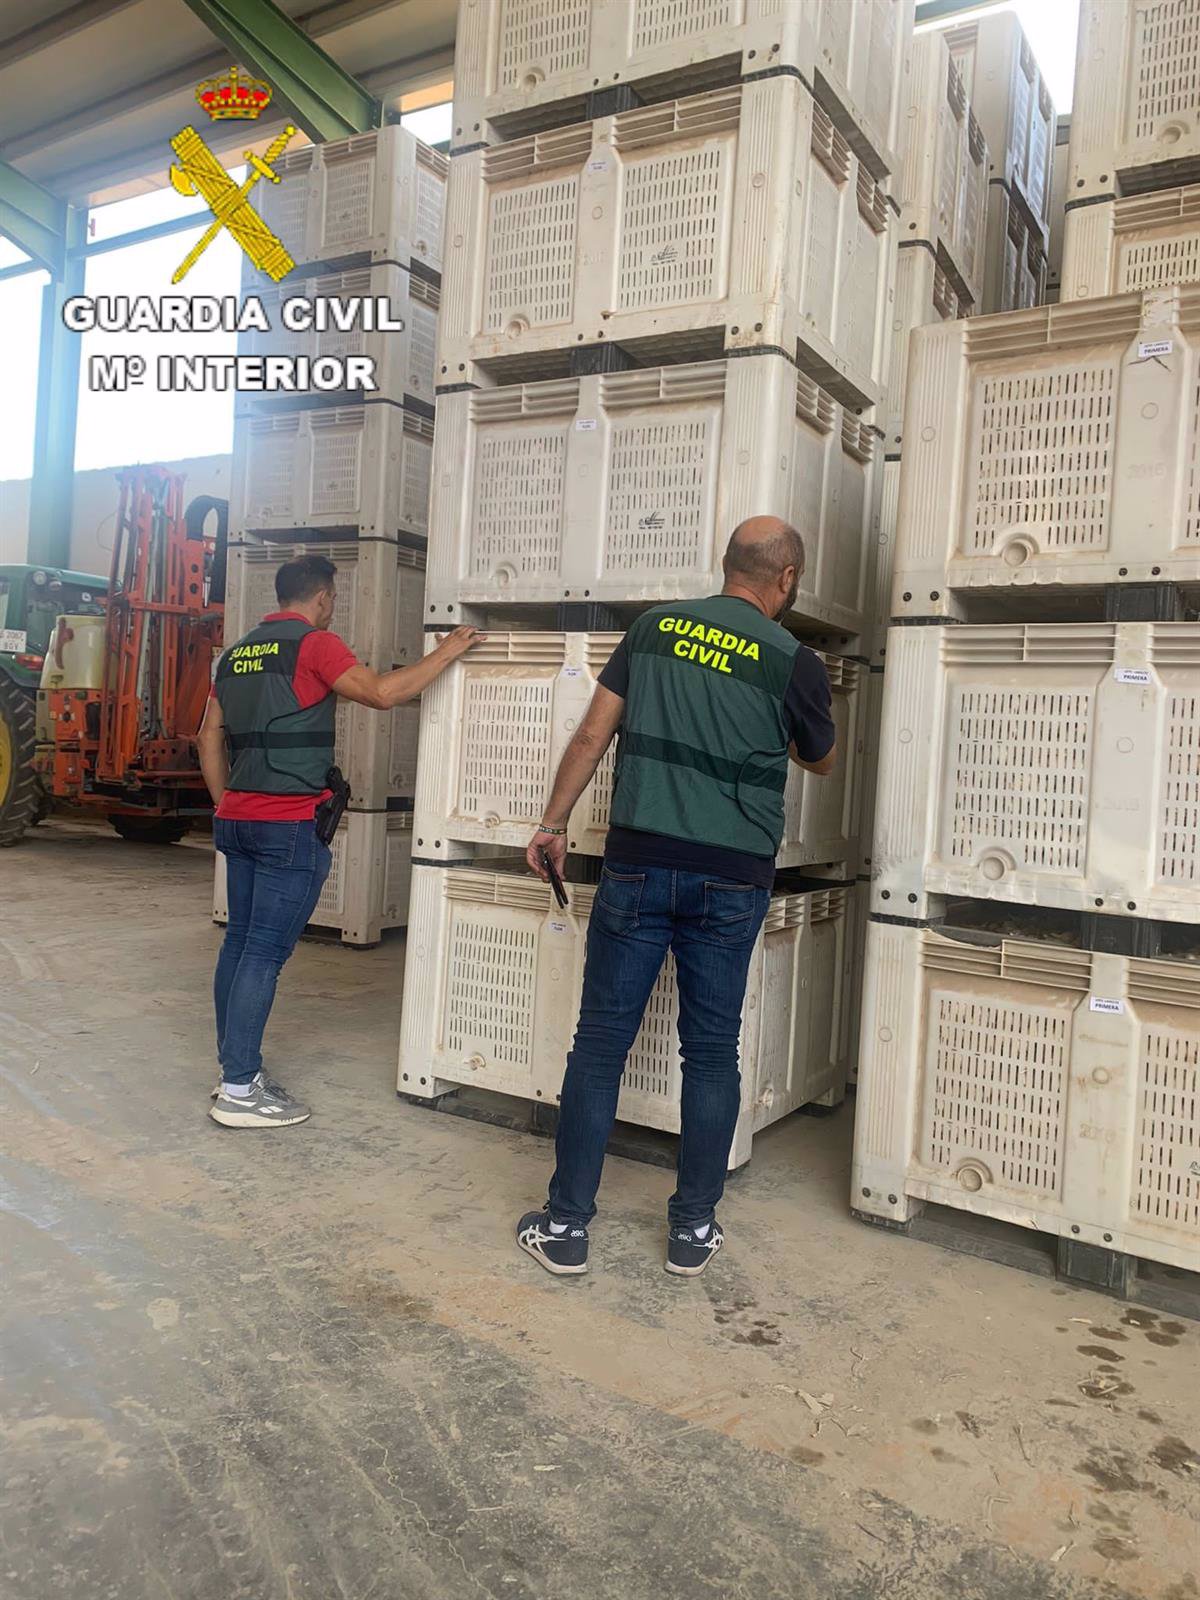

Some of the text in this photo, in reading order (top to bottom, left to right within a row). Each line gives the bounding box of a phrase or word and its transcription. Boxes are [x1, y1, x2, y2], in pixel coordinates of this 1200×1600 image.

[658, 617, 760, 661] GUARDIA
[673, 639, 732, 673] CIVIL
[233, 658, 264, 674] CIVIL
